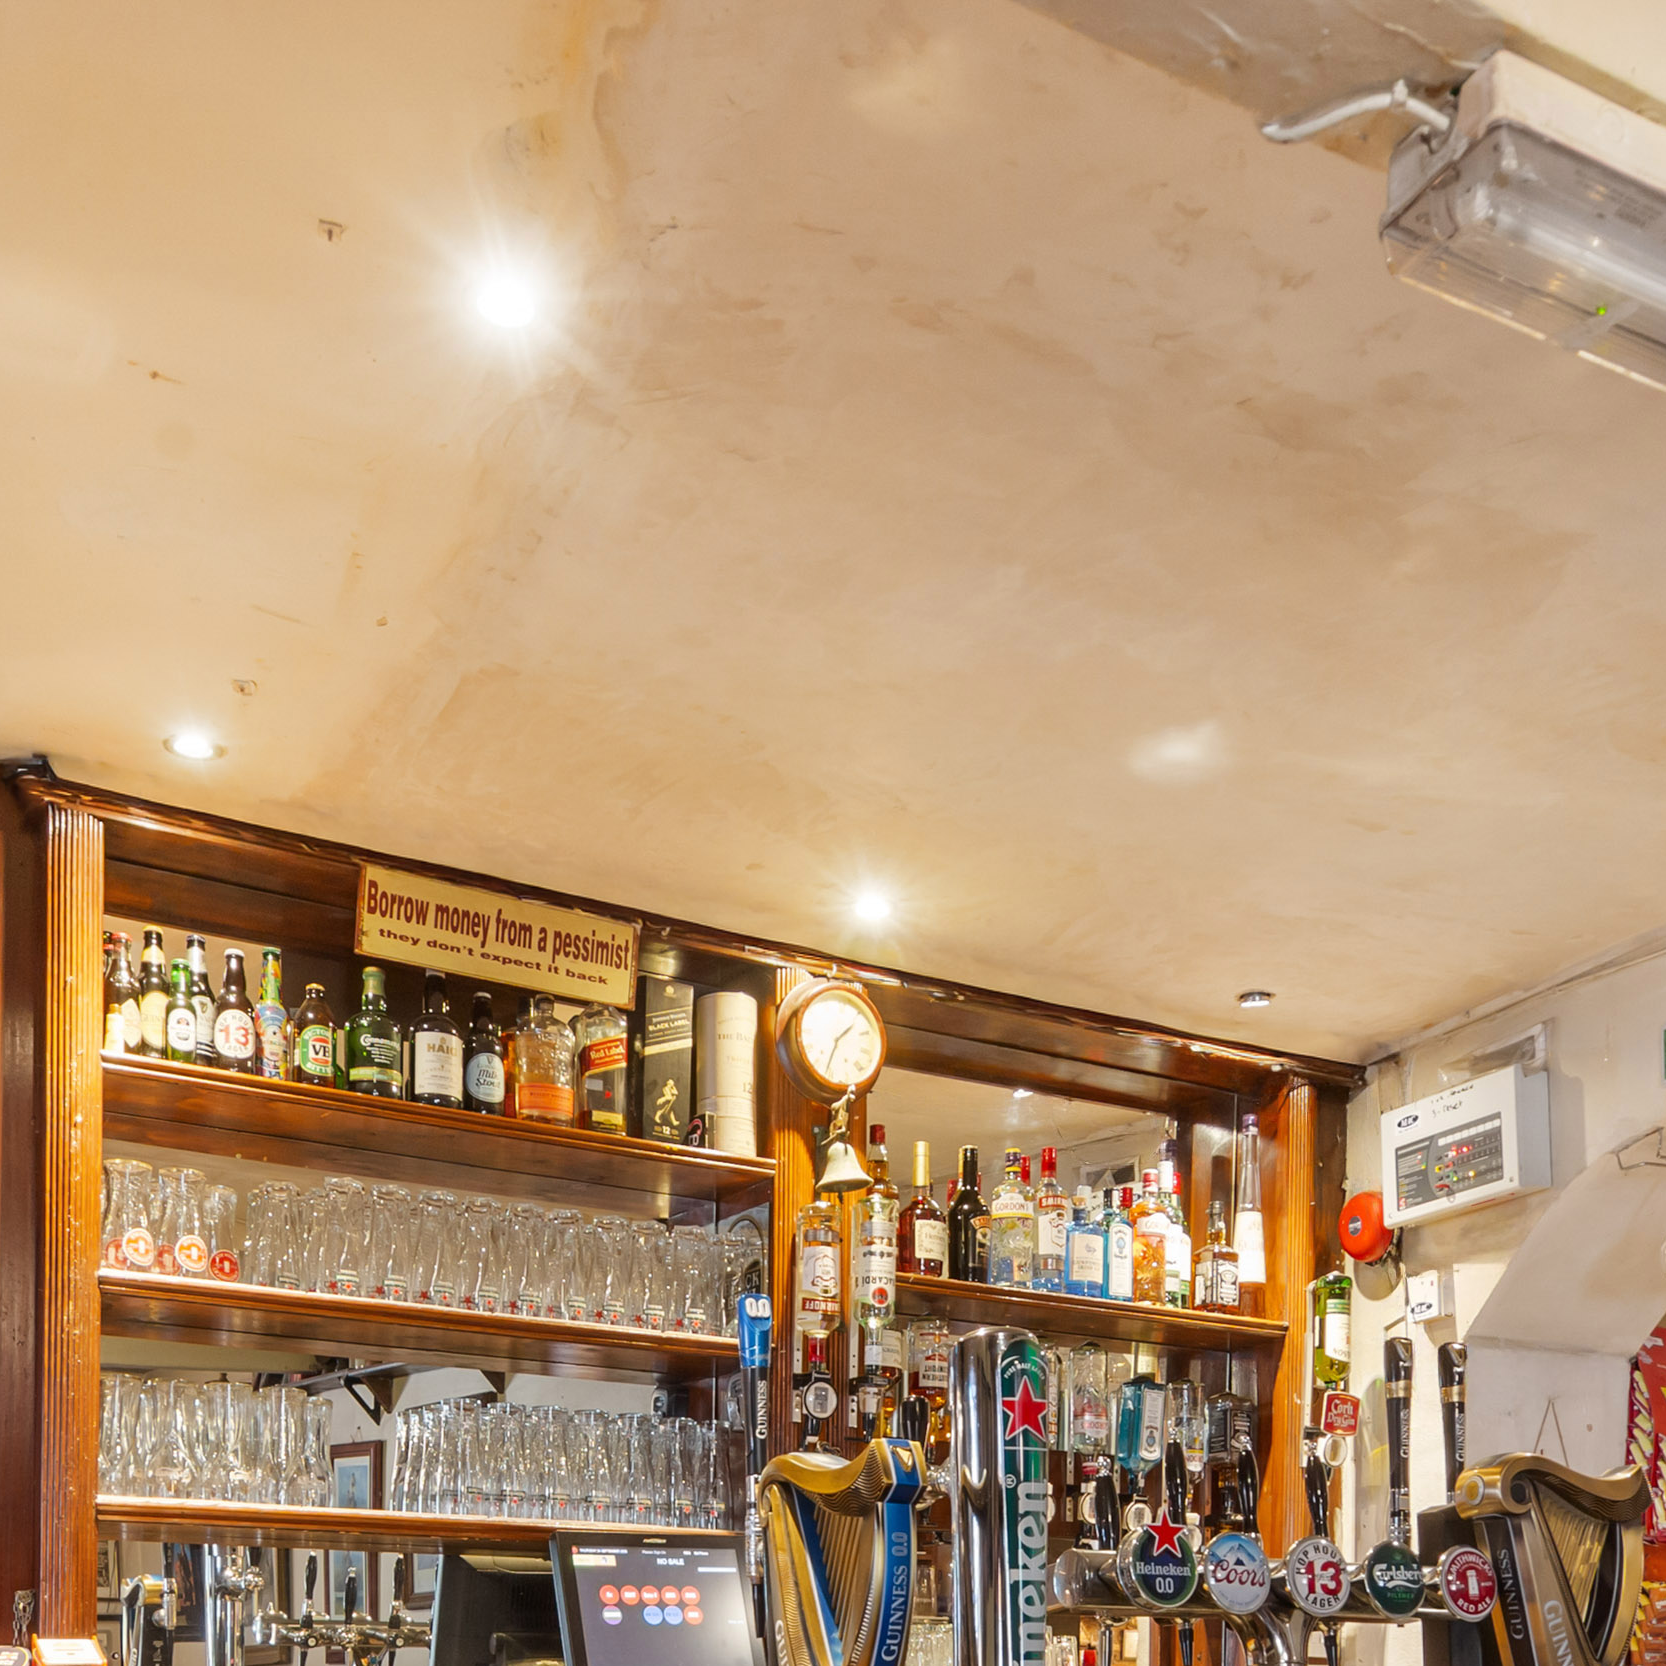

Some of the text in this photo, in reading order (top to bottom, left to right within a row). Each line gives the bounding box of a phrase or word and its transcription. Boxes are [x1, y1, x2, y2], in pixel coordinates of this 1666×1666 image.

[366, 879, 630, 972] Borrow money from a pessimist
[378, 927, 609, 986] they don't expect it back
[219, 1024, 250, 1047] 13
[648, 1022, 670, 1032] BLACK
[670, 1018, 691, 1028] LABEL
[311, 1044, 331, 1058] VB
[426, 1041, 458, 1058] HAIG
[590, 1049, 605, 1061] Red
[605, 1044, 627, 1058] Label
[1016, 1361, 1032, 1371] MALT
[755, 1380, 768, 1440] GUINNESS
[1400, 1408, 1410, 1458] GUINNESS
[1455, 1412, 1466, 1462] GUINNESS
[656, 1557, 685, 1566] NO SALE
[1135, 1561, 1192, 1577] Heineken
[1213, 1558, 1266, 1588] Coors
[1295, 1550, 1311, 1575] HOP
[1155, 1577, 1175, 1594] 0.0
[1304, 1560, 1343, 1596] 13
[881, 1531, 908, 1663] GUINNESS 0.0
[1304, 1594, 1341, 1609] LAGER
[1457, 1596, 1492, 1612] RED ALE
[1495, 1548, 1525, 1640] GUINNESS
